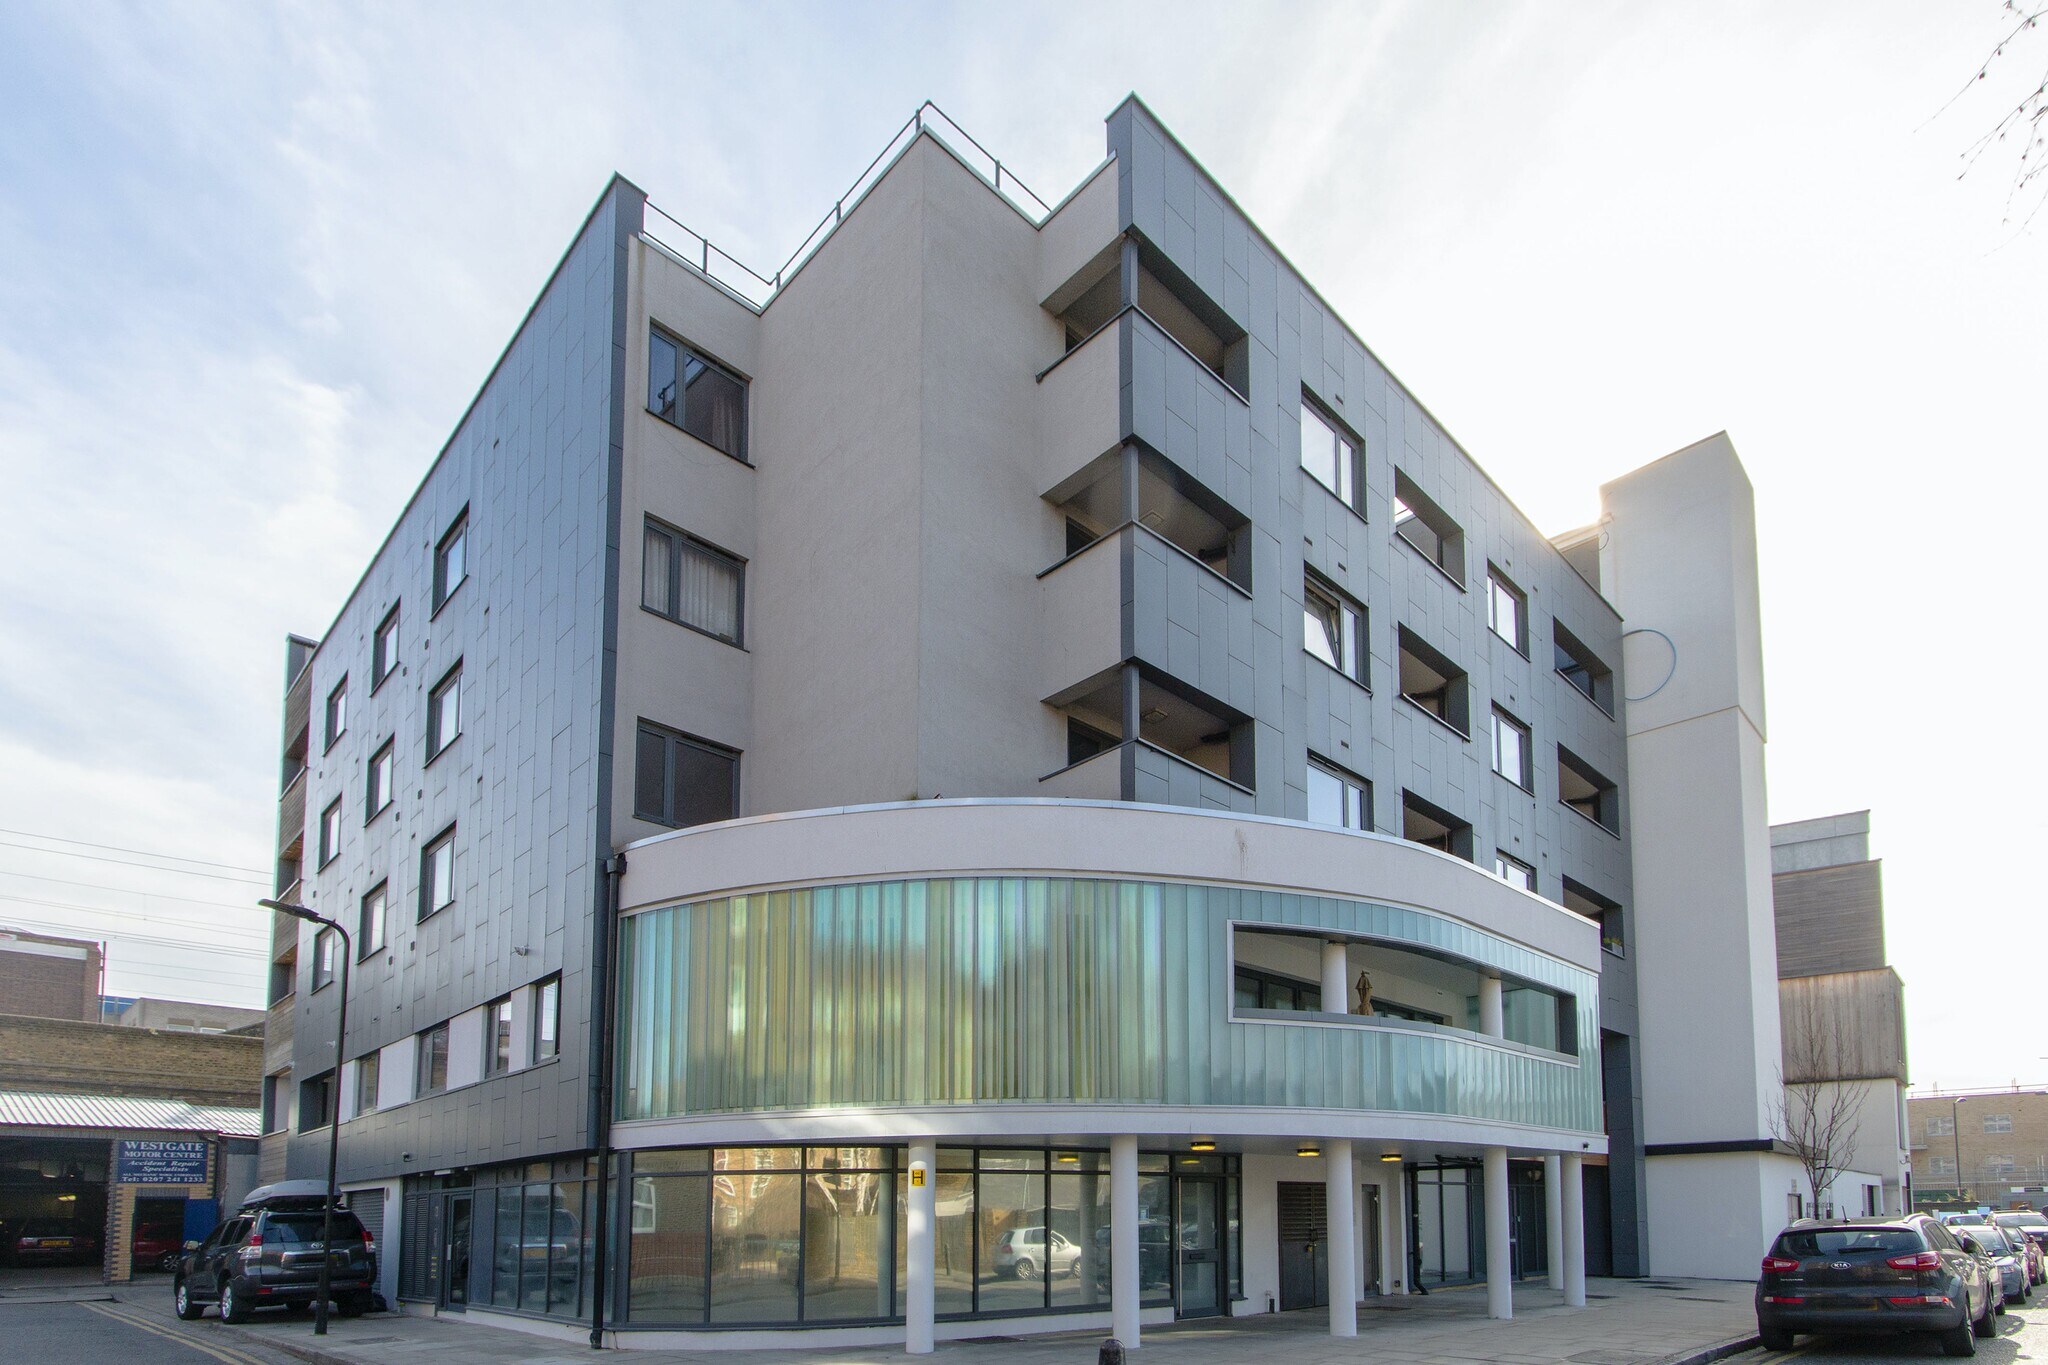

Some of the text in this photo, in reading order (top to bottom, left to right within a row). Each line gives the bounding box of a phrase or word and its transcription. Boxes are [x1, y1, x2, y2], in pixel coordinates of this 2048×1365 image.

[125, 1141, 204, 1151] WESTGATE
[163, 1151, 204, 1159] CENTRE
[912, 1170, 923, 1184] H
